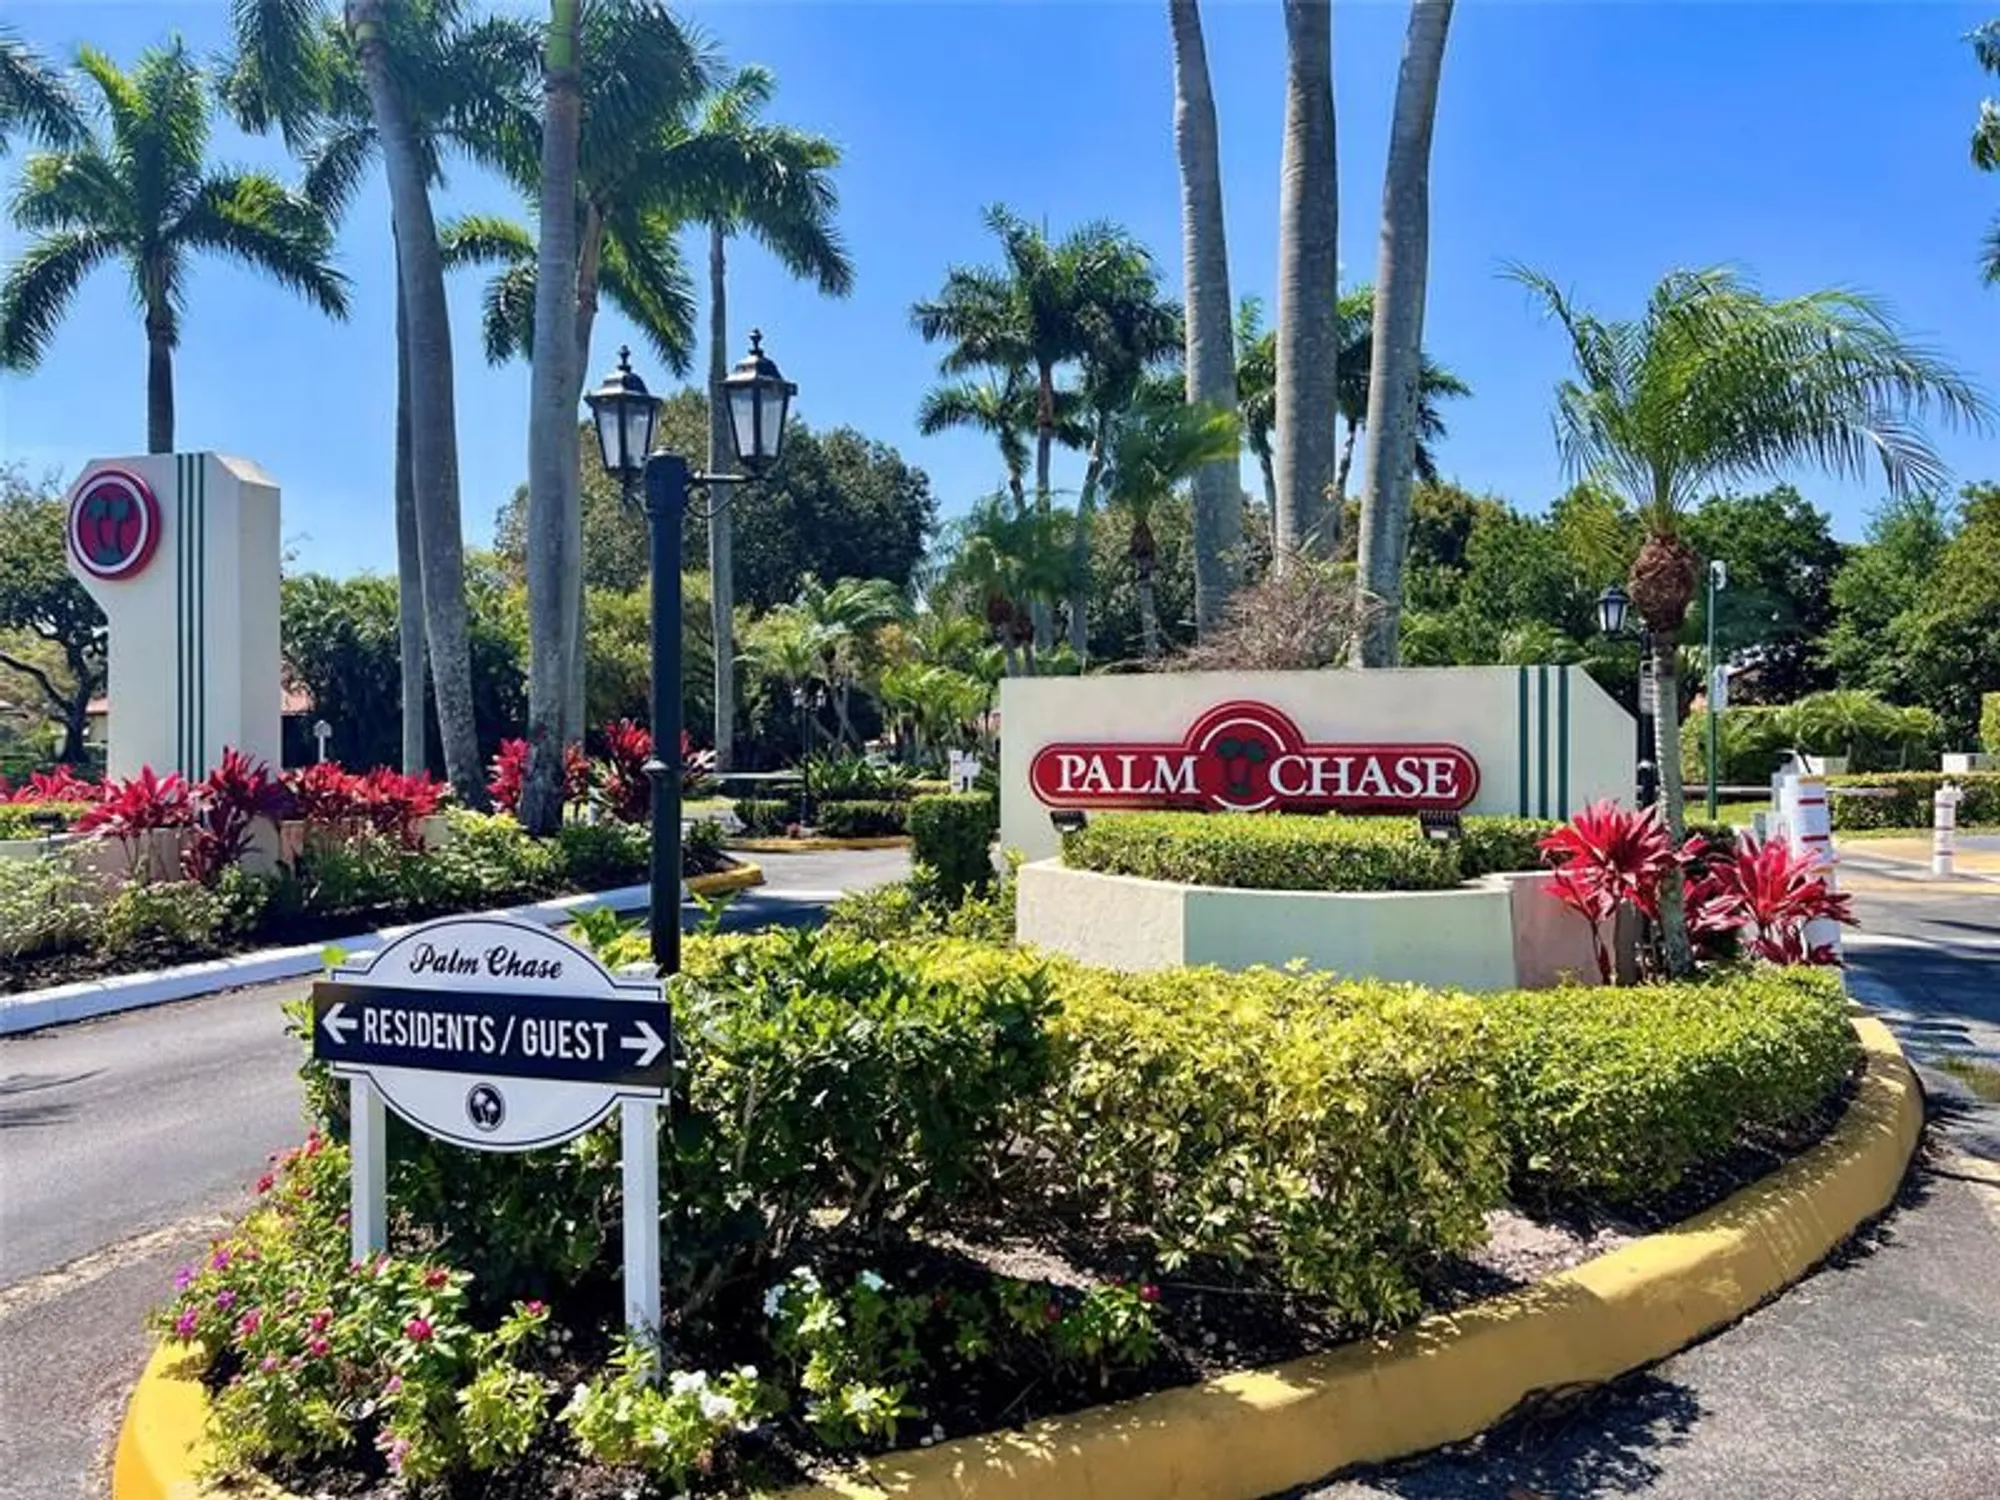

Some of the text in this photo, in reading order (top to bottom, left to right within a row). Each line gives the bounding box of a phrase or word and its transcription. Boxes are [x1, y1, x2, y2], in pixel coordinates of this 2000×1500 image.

[1056, 754, 1459, 799] PALM CHASE
[409, 942, 563, 979] Palm Chase
[363, 1007, 497, 1055] RESIDENTS
[521, 1017, 609, 1062] GUEST
